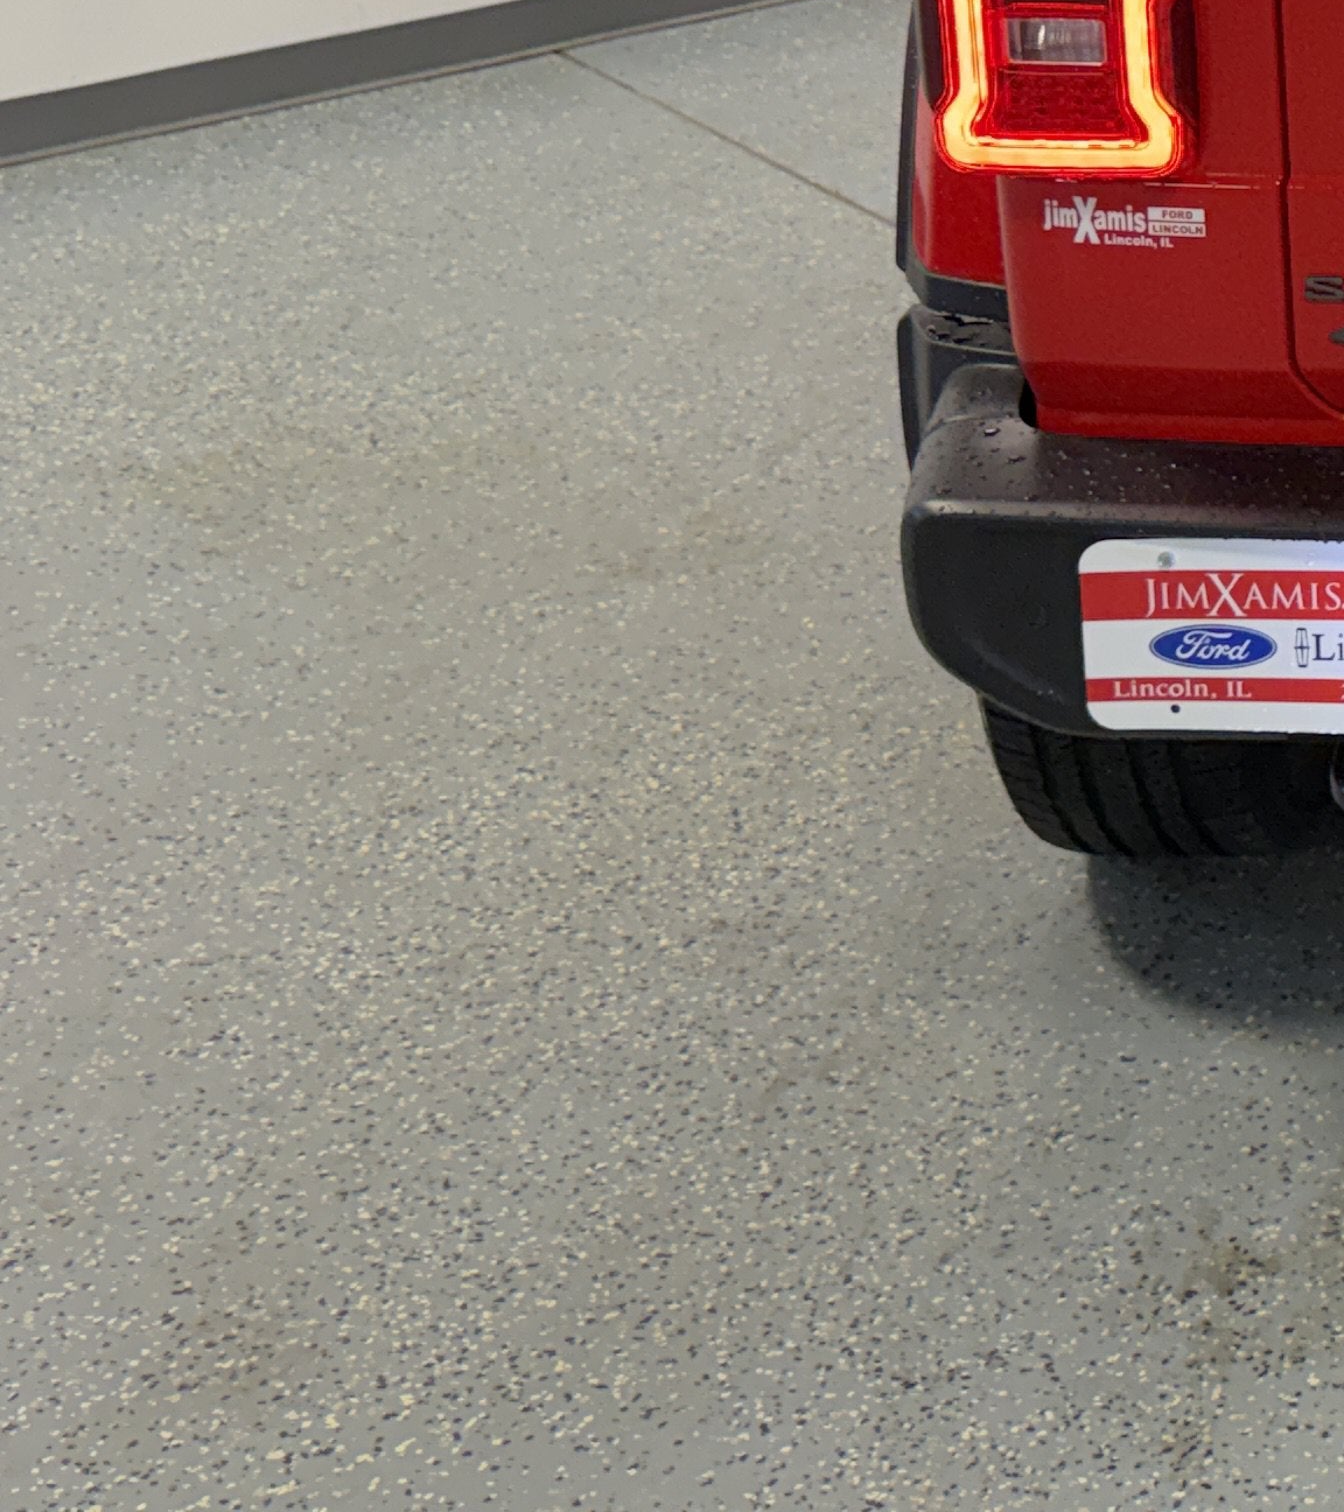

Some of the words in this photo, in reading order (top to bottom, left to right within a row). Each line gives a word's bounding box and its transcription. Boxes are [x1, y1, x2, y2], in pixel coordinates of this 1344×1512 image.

[1043, 195, 1147, 245] jimXamis
[1161, 209, 1194, 220] FORD
[1152, 223, 1204, 235] LINCOLN
[1104, 233, 1159, 250] Lincoln,
[1160, 236, 1175, 249] IL
[1174, 630, 1252, 661] Ford
[1112, 678, 1217, 700] Lincoln,
[1227, 680, 1252, 699] IL
